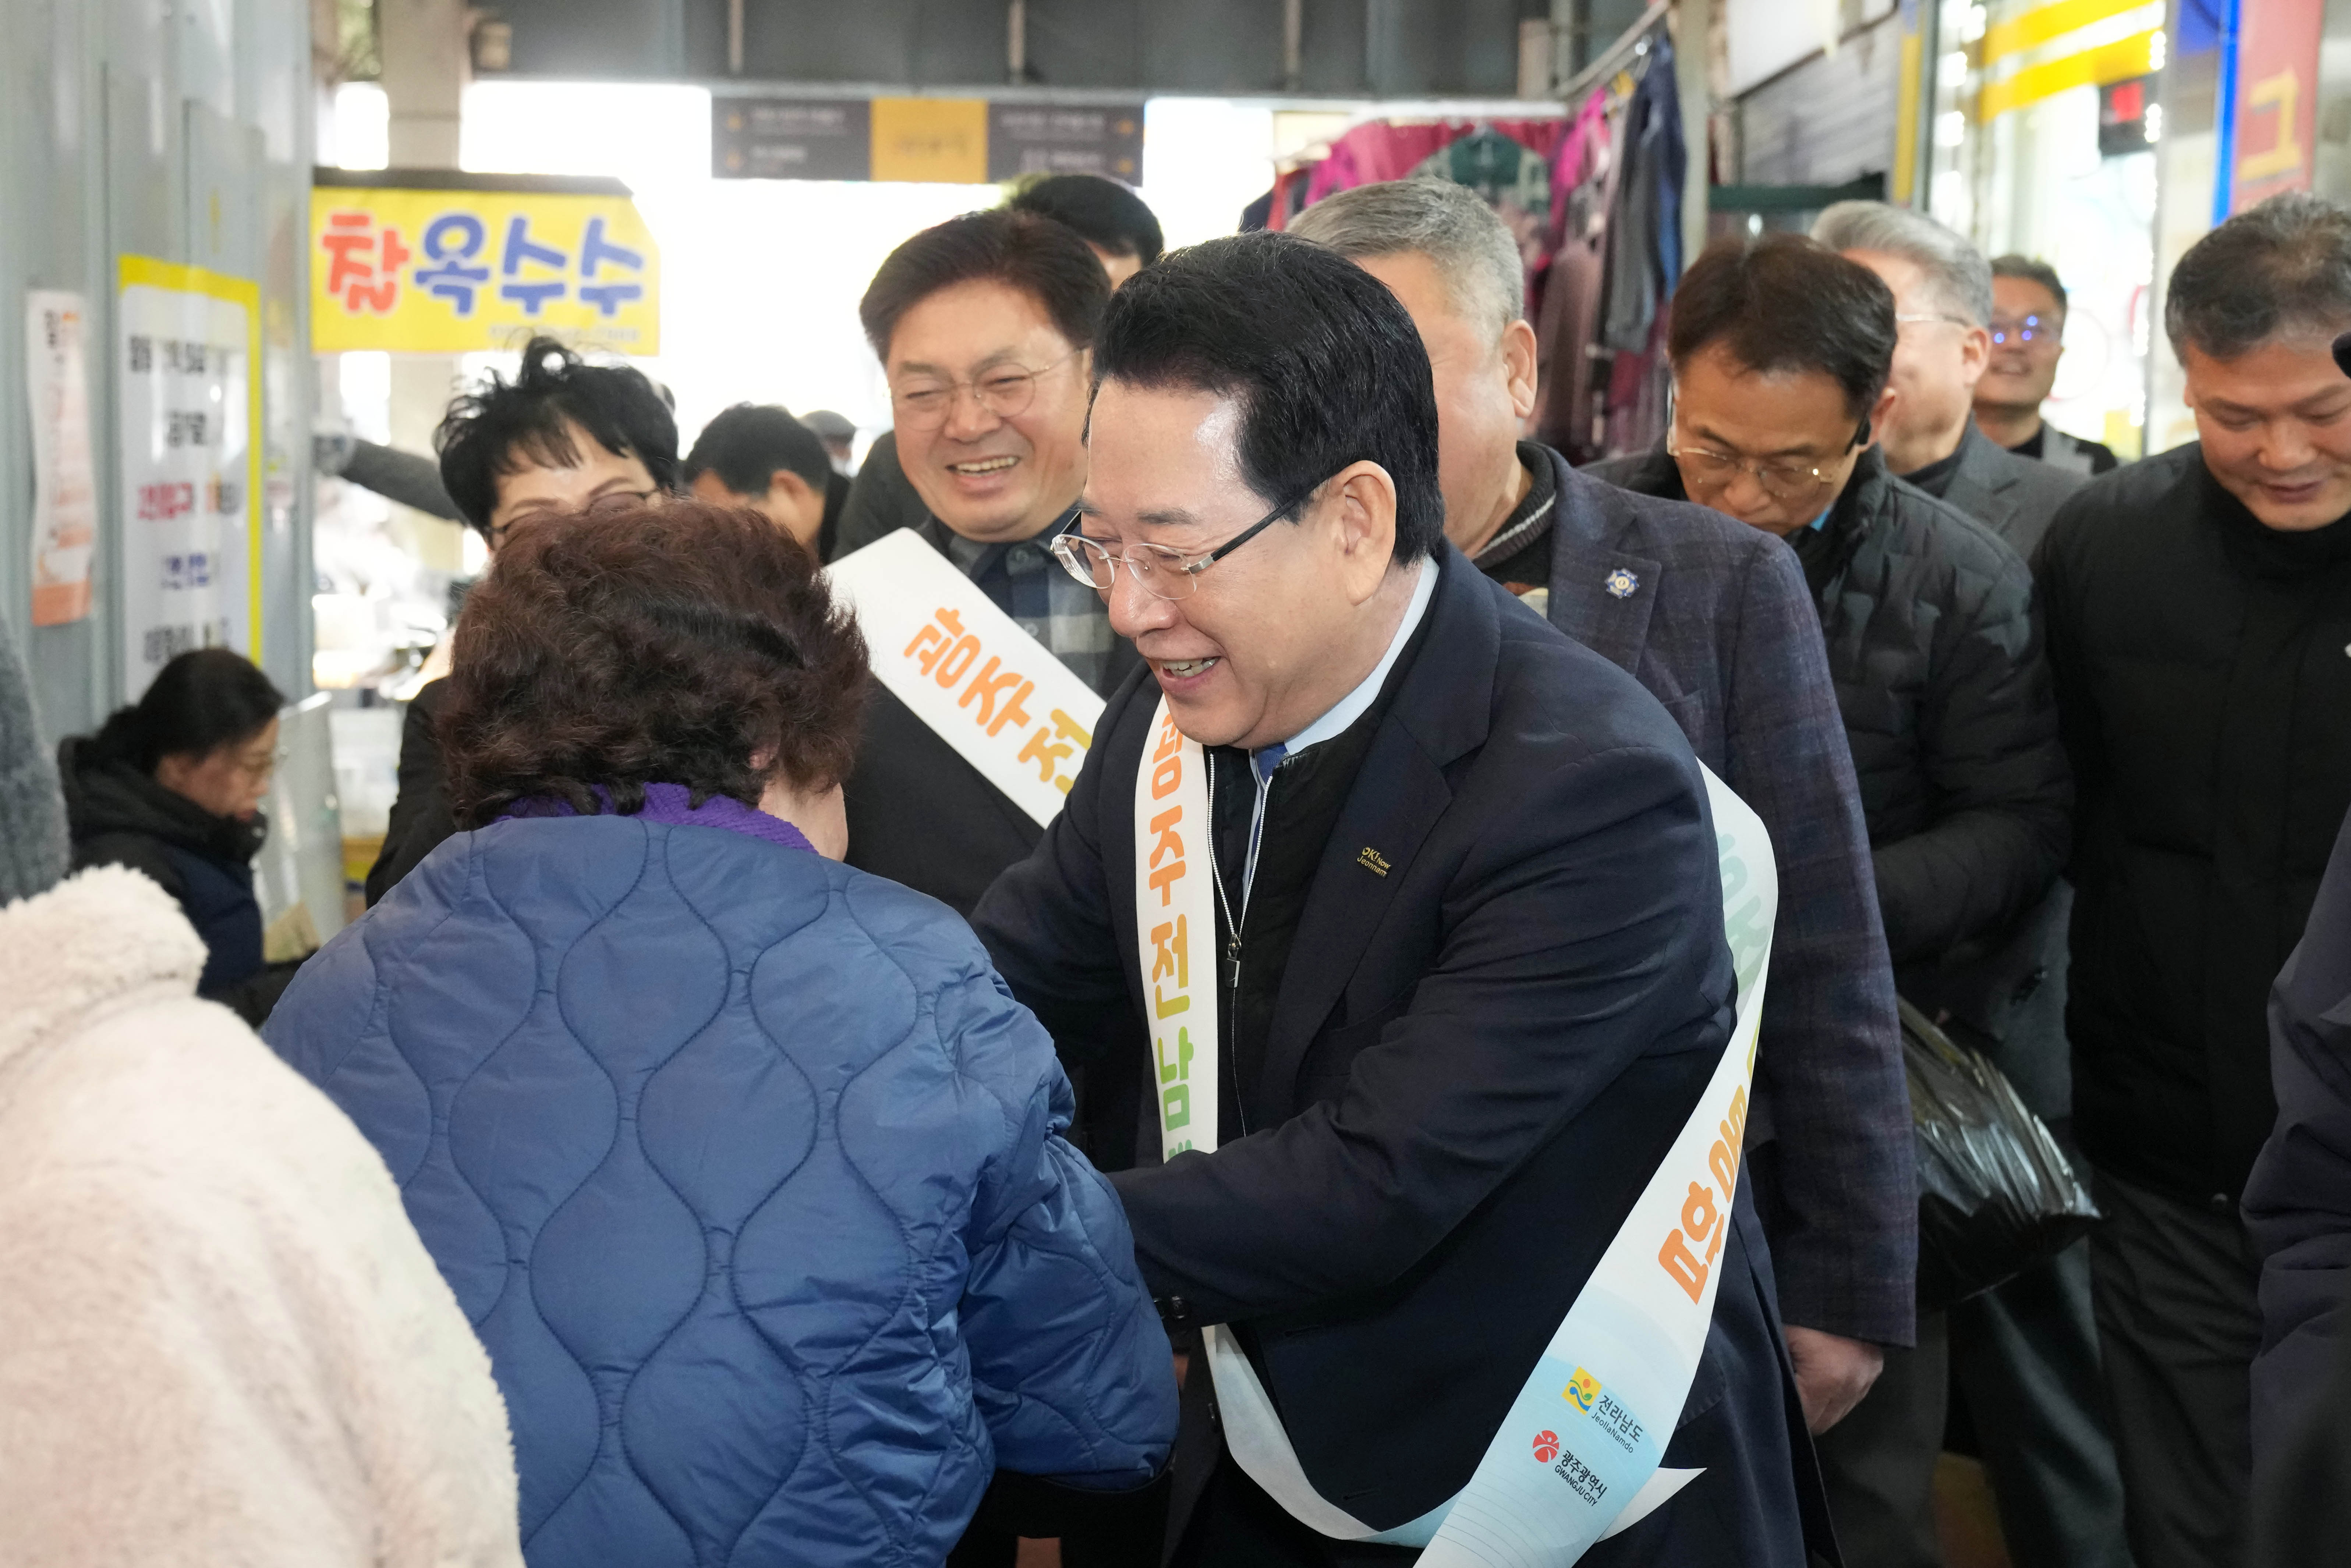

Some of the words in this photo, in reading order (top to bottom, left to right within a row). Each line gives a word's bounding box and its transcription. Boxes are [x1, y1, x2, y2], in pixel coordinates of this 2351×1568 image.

[322, 213, 643, 315] 찰옥수수
[1357, 856, 1387, 877] Jeonnam
[1149, 713, 1194, 1159] 광주전남
[1591, 1412, 1633, 1453] JeollaNamdo
[1599, 1395, 1643, 1443] 전라남도
[1555, 1465, 1584, 1495] GWANGJU
[1584, 1492, 1597, 1507] CITY
[1561, 1450, 1607, 1499] 광주광역시
